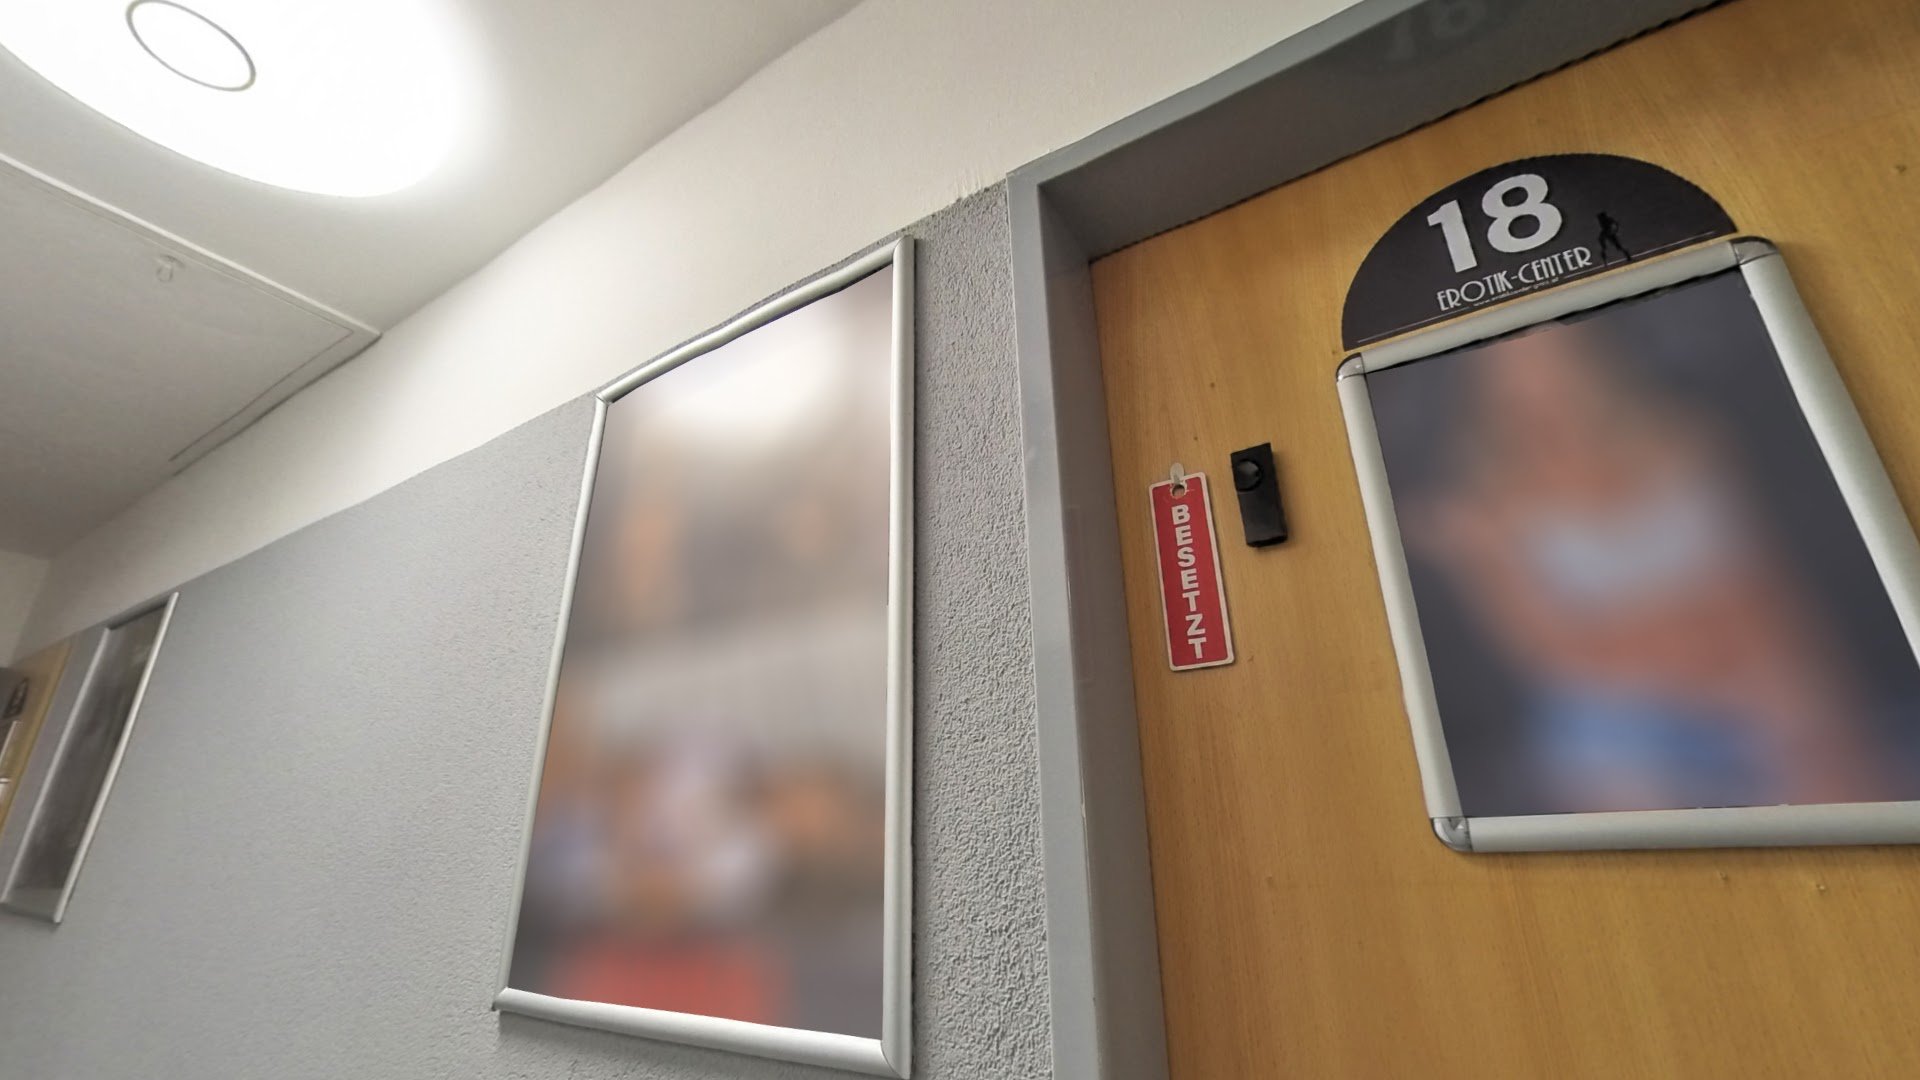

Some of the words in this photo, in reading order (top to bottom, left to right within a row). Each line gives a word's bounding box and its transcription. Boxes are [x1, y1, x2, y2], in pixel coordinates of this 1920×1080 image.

[1427, 173, 1563, 274] 18
[1436, 246, 1593, 311] EROTIK-CENTER
[1171, 504, 1207, 659] BESETZT
